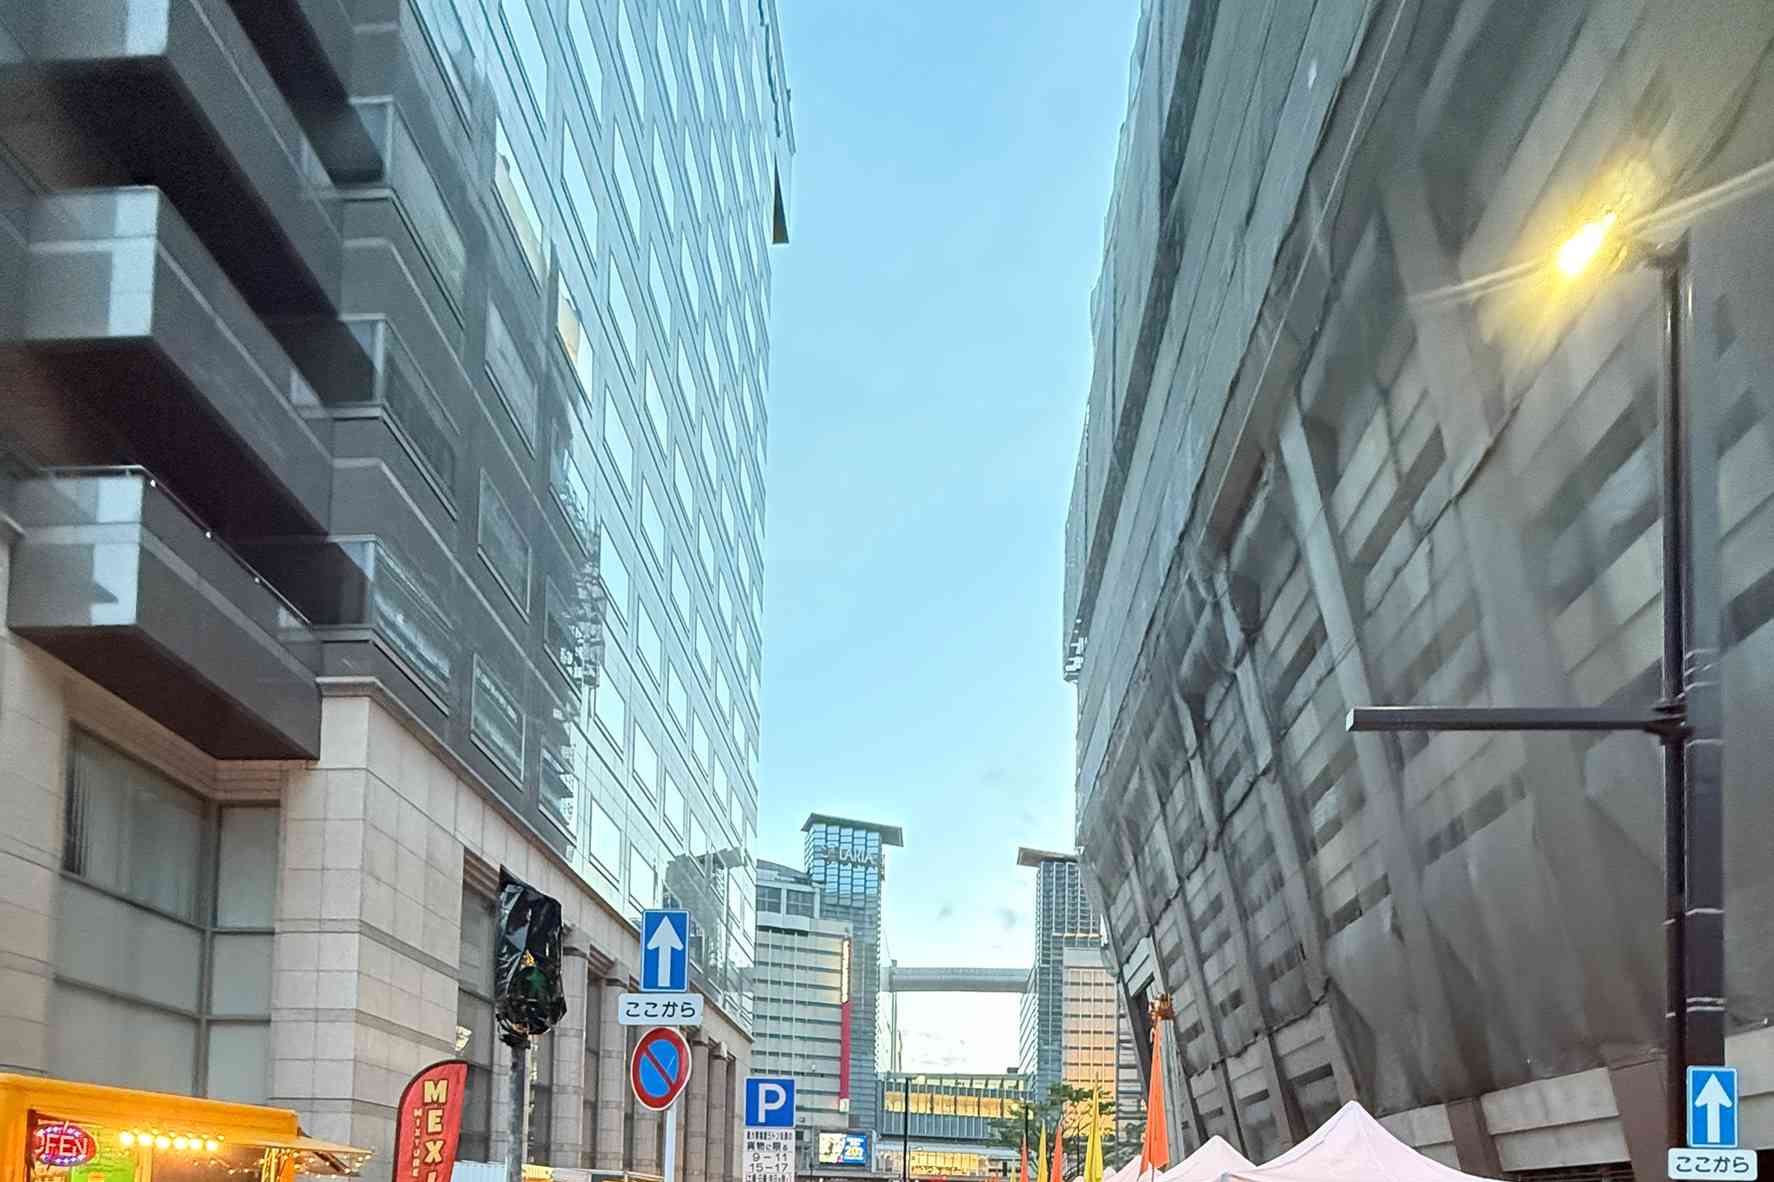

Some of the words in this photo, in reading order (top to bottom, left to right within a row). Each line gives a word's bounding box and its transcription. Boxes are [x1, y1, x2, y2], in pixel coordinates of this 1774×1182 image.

[626, 1001, 696, 1017] ここから
[758, 1083, 787, 1123] P
[1676, 1156, 1749, 1173] ここから
